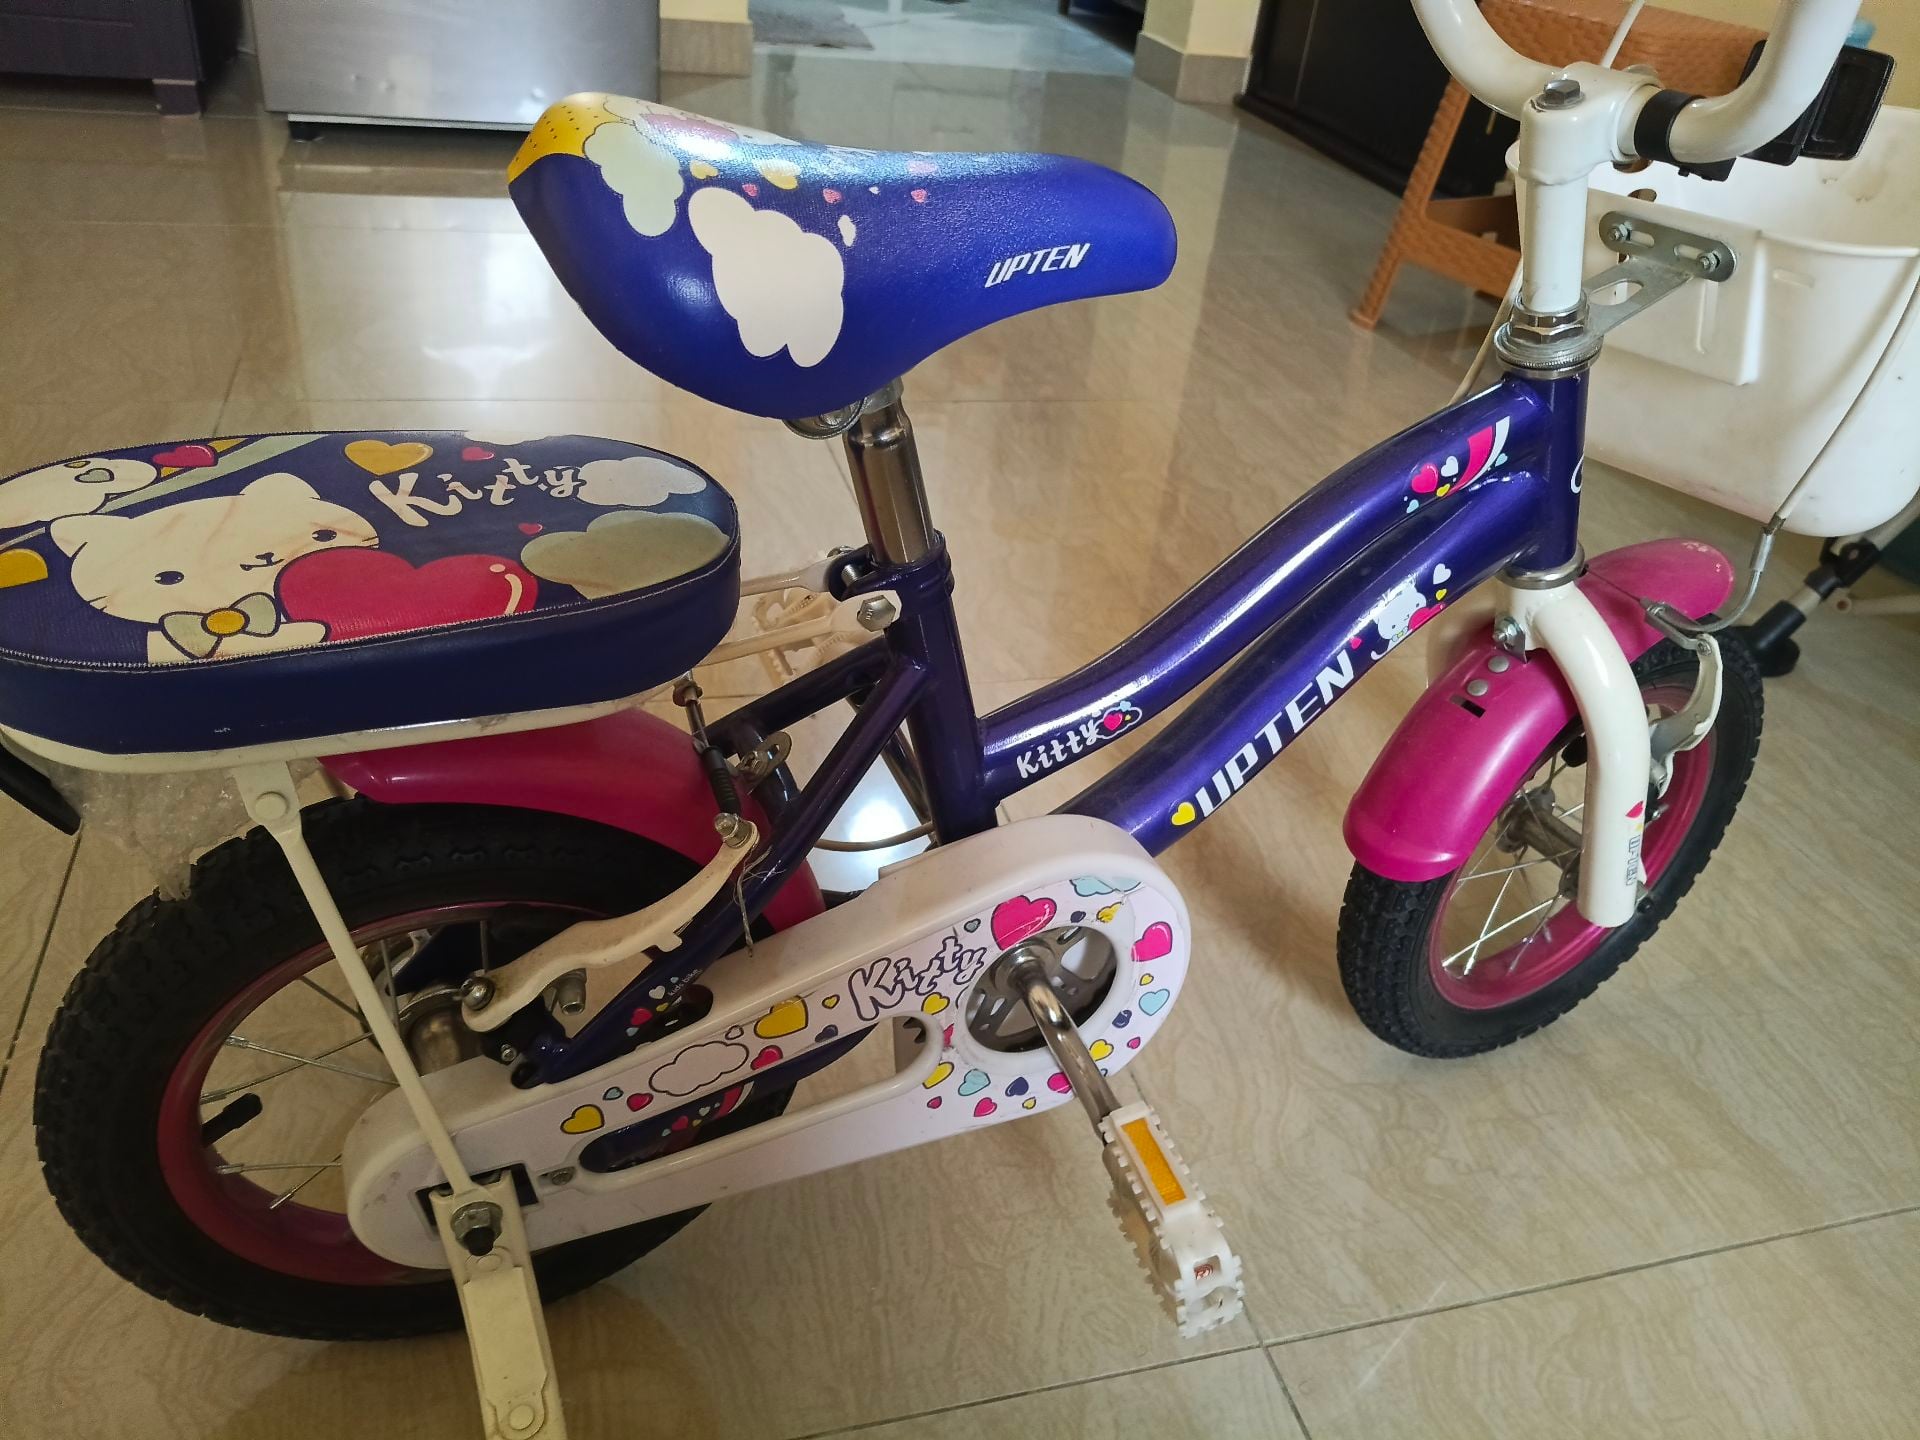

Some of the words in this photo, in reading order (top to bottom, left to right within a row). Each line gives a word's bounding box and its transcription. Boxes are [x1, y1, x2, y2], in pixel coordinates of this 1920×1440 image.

[984, 243, 1091, 288] UPTEN
[368, 458, 586, 527] Kitty
[1016, 719, 1099, 779] Kitty
[1195, 649, 1354, 818] UPTEN
[848, 936, 987, 1021] Kitty
